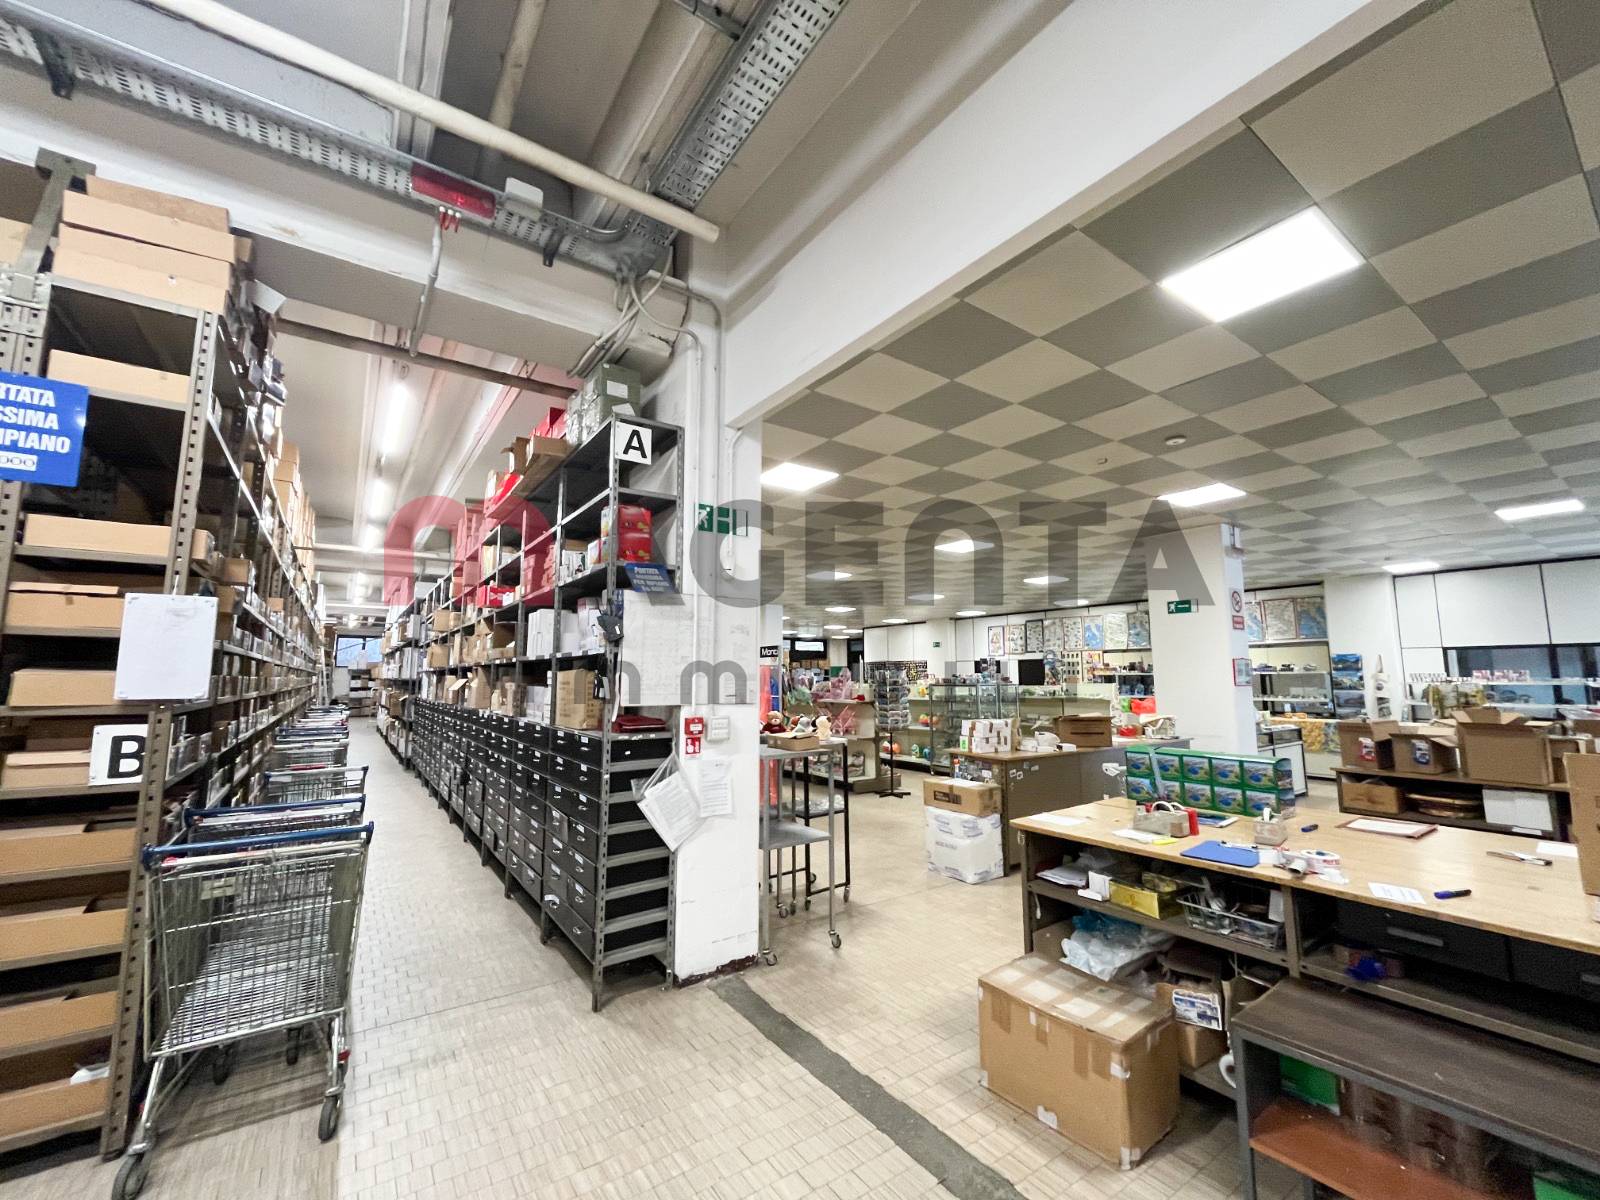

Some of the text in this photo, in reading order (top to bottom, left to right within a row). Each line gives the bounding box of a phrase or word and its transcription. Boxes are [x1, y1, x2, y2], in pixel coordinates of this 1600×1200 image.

[0, 404, 59, 430] SIMA
[623, 429, 648, 459] A
[107, 735, 146, 779] B
